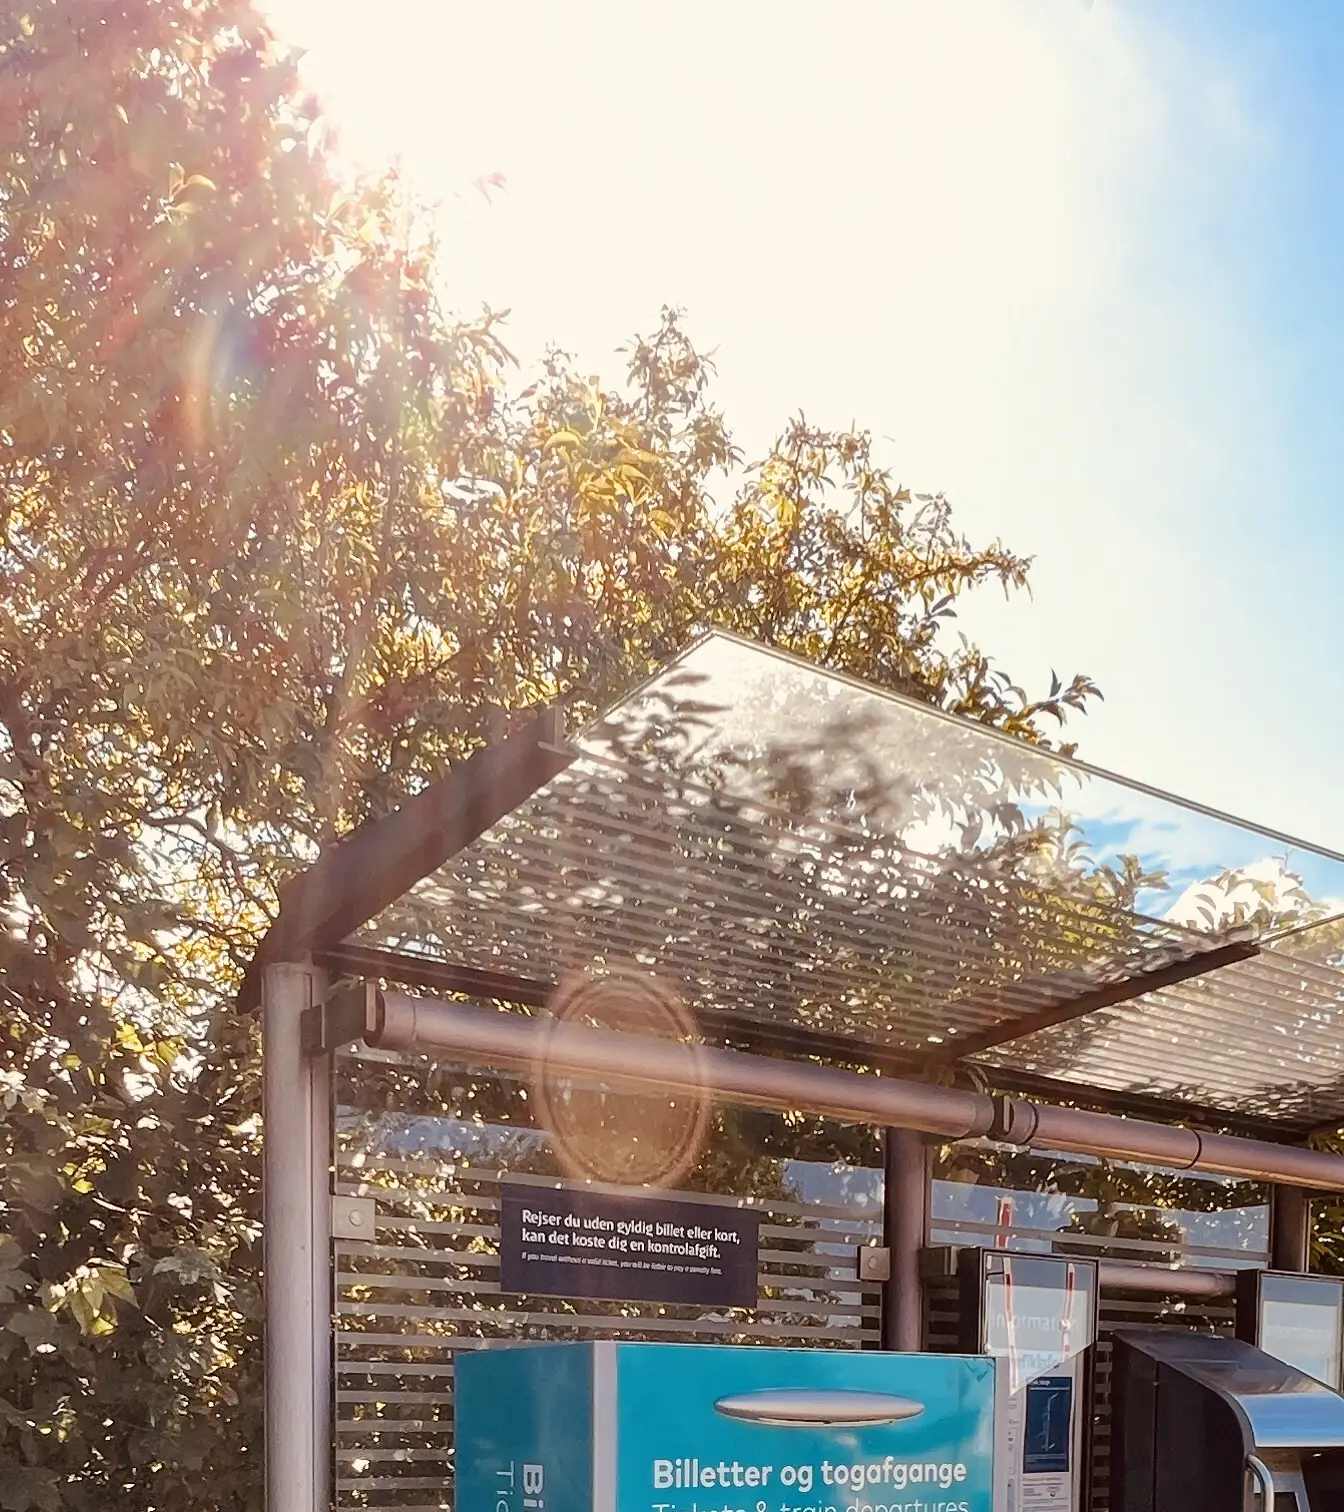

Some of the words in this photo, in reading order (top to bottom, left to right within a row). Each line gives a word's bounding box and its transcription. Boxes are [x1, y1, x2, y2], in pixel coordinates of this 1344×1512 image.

[522, 1209, 562, 1227] Rejser
[564, 1214, 581, 1229] du
[583, 1216, 614, 1231] uden
[617, 1220, 654, 1237] gyldig
[656, 1222, 684, 1239] billet
[687, 1226, 712, 1240] eller
[714, 1228, 741, 1245] kort,
[522, 1228, 546, 1243] kan
[548, 1230, 570, 1245] det
[572, 1232, 606, 1248] koste
[608, 1236, 628, 1252] dig
[629, 1240, 645, 1252] en
[647, 1239, 721, 1259] kontrolafgift.
[654, 1458, 773, 1489] Billetter
[780, 1465, 813, 1493] og
[821, 1456, 967, 1491] togafgange
